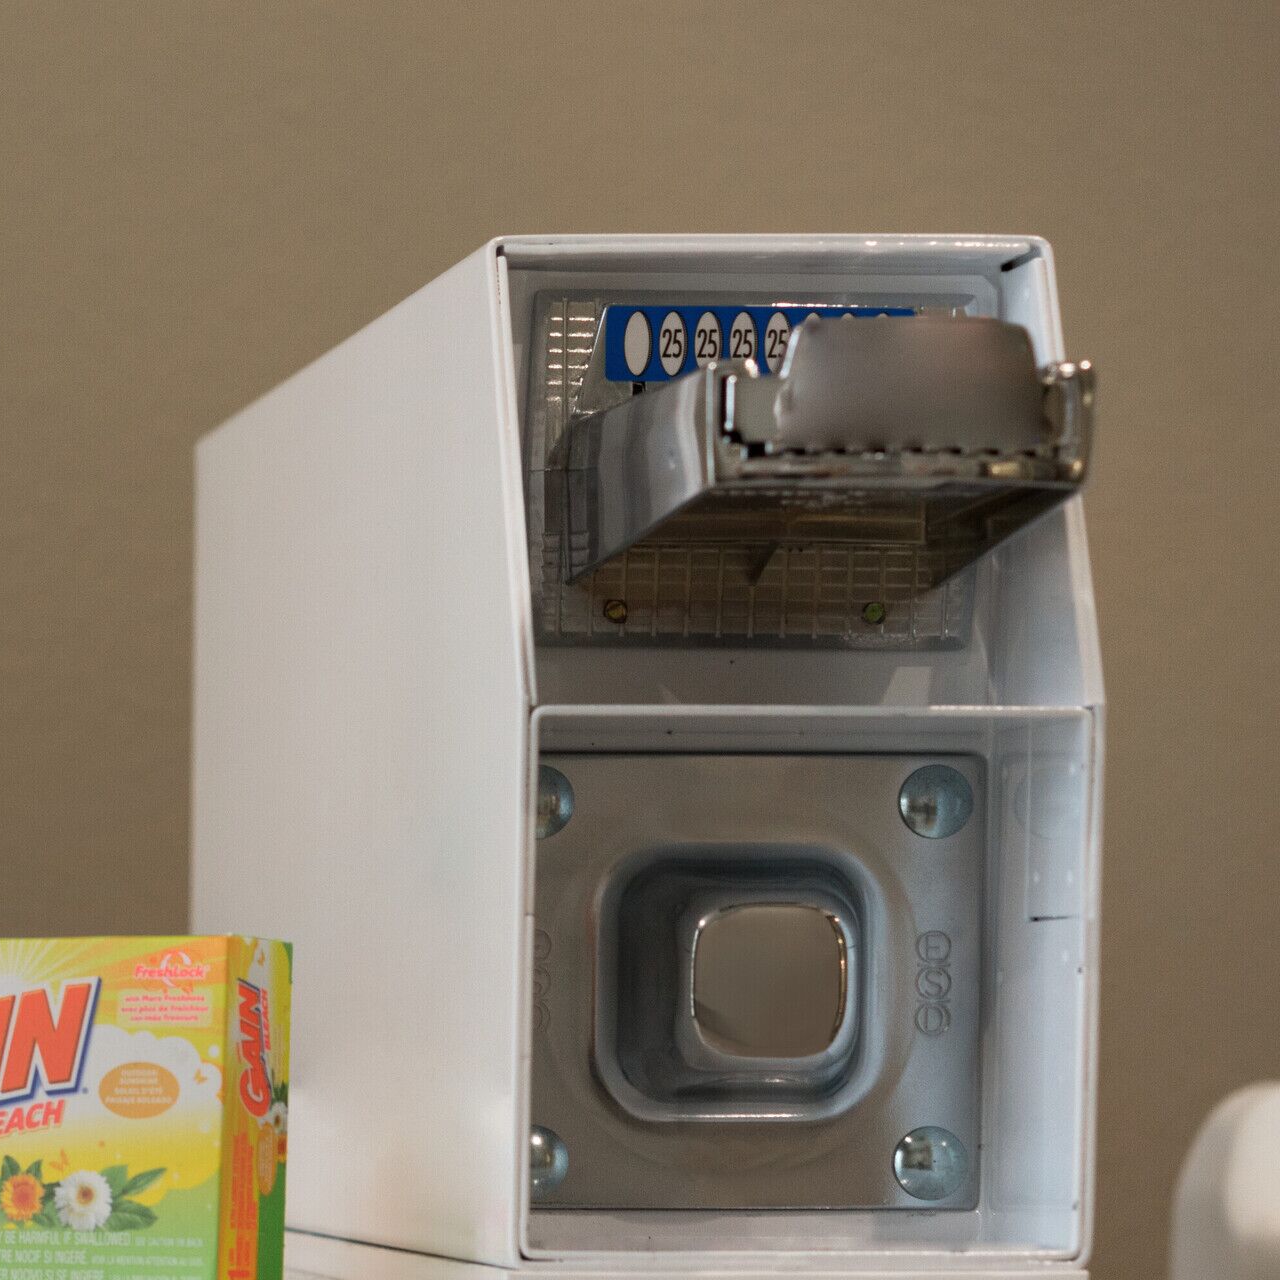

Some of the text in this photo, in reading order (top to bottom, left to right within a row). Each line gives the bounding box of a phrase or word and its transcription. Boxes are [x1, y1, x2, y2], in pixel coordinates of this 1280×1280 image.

[662, 328, 787, 358] 25 25 25 25
[238, 982, 271, 1117] GAIN
